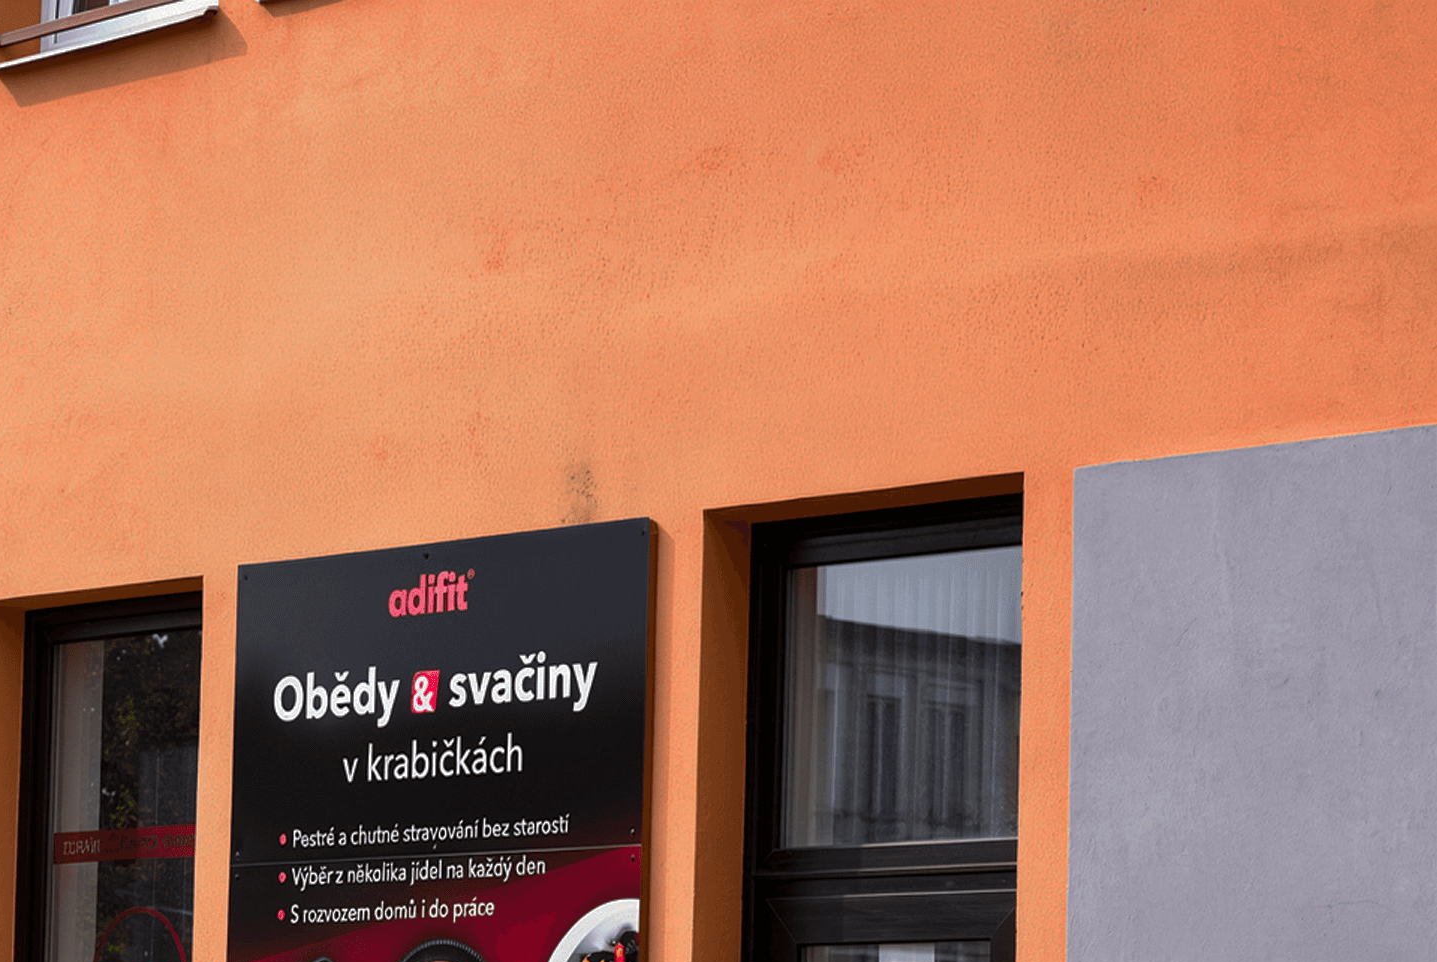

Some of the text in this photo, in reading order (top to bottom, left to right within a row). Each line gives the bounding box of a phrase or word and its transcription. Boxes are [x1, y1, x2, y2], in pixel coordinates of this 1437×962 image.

[388, 571, 468, 618] adifit
[274, 651, 598, 728] Obědy & svačiny
[343, 732, 524, 783] v krabičkách
[292, 813, 570, 848] Pestré a chutné stravování bez starostí
[291, 854, 546, 892] Výběr z několika jídel na každý den
[290, 896, 495, 924] S rozvozem domů i do práce
